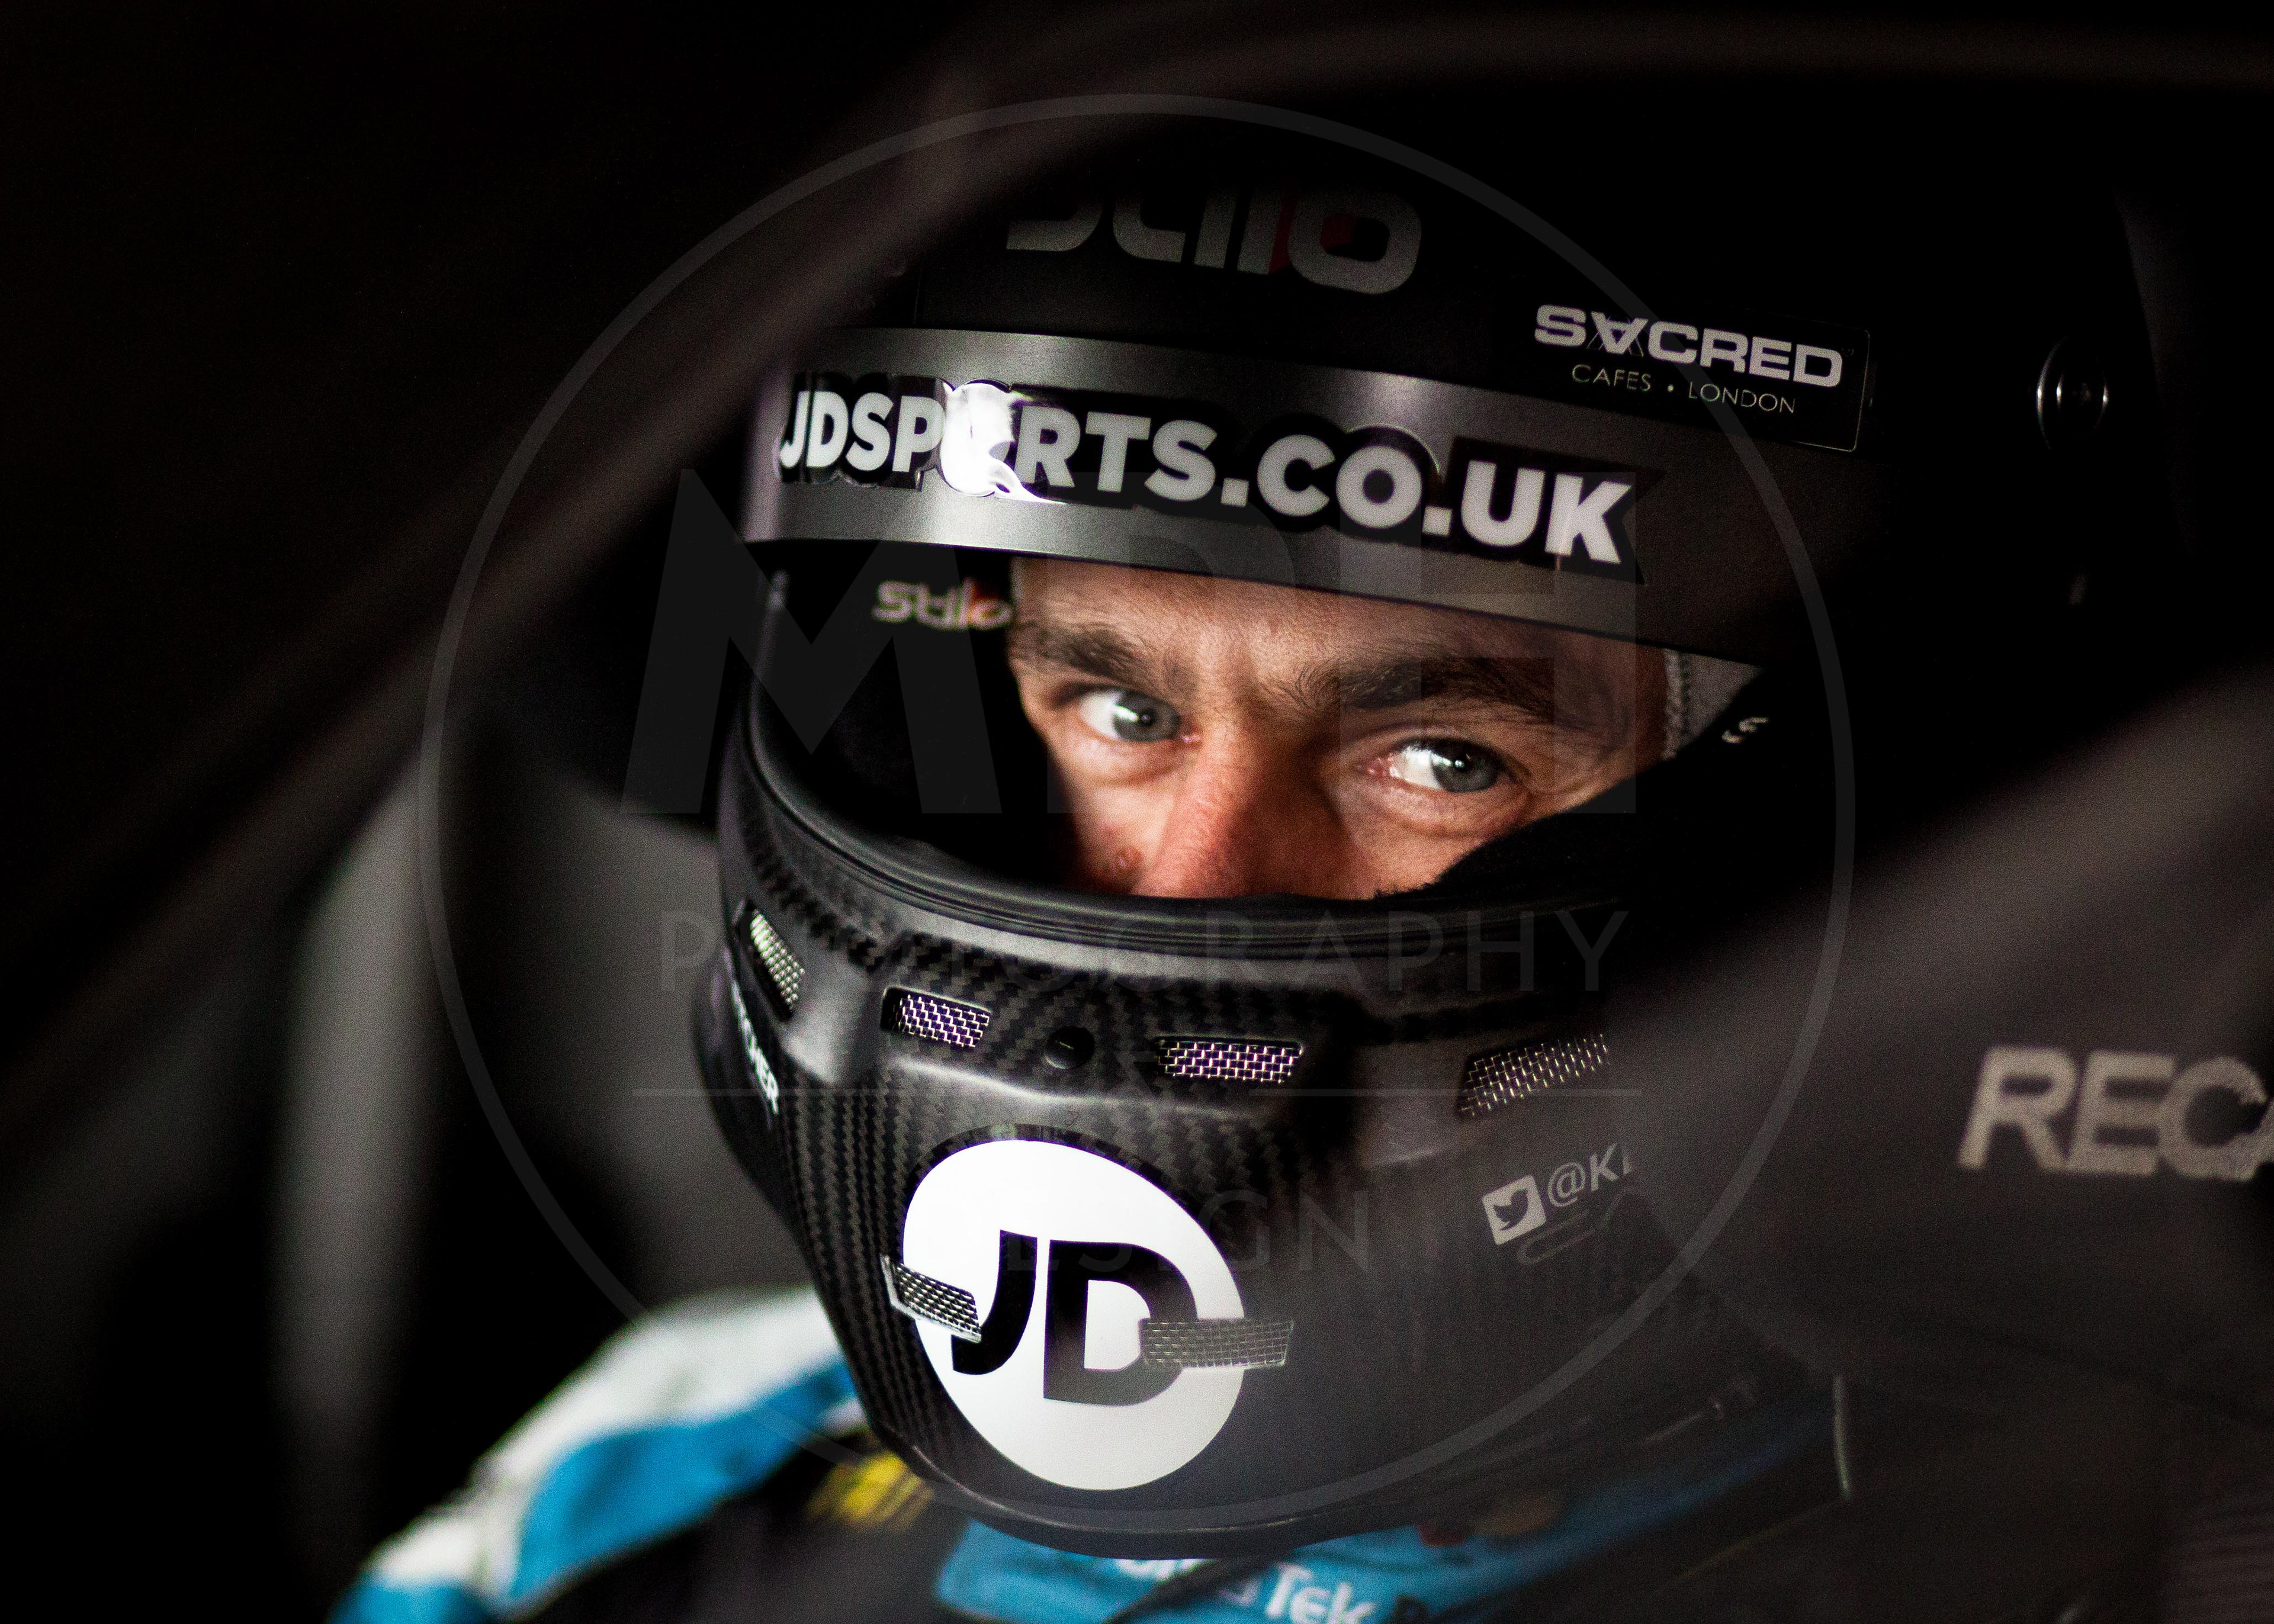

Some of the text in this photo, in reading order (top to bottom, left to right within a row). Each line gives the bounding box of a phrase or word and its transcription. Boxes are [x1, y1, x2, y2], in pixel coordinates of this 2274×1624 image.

[1571, 364, 1796, 414] CAFES LONDON
[952, 1230, 1197, 1406] JD
